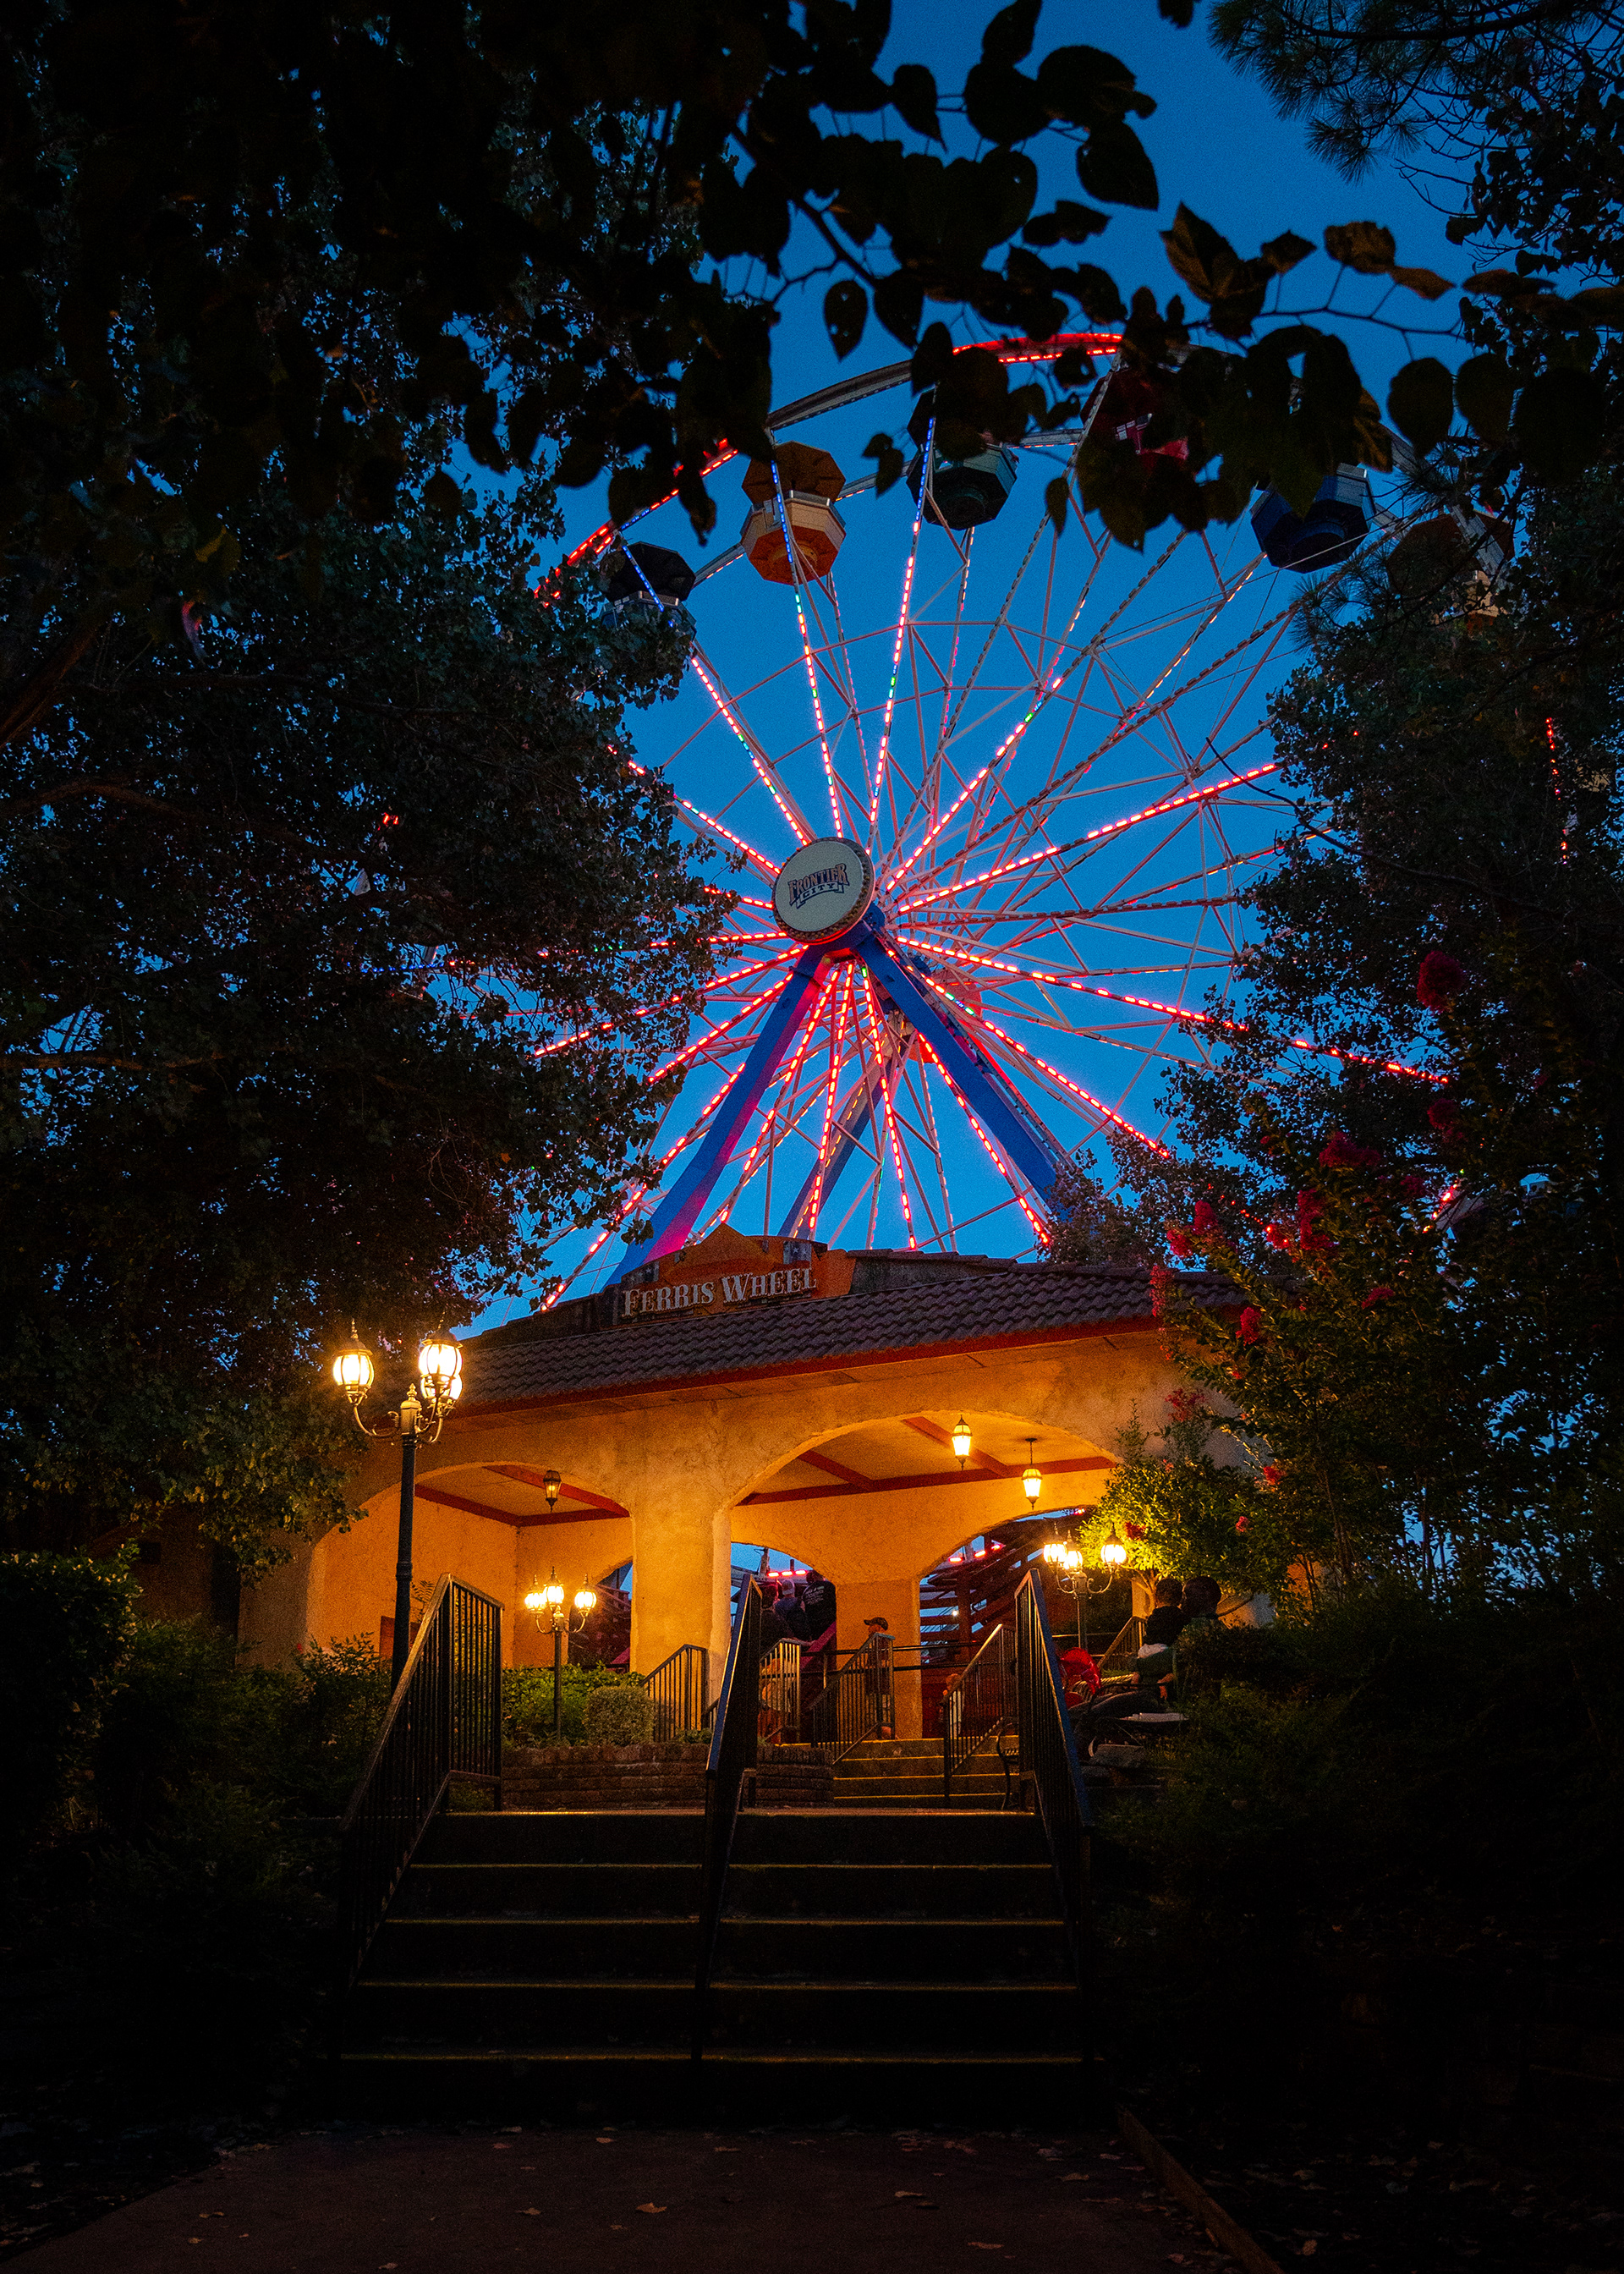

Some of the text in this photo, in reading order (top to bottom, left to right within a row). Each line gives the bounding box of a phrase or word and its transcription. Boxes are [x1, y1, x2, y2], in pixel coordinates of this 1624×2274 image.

[788, 863, 849, 905] FRONTIER
[803, 883, 835, 898] CITY
[622, 1268, 816, 1317] FERRIS WHEEL
